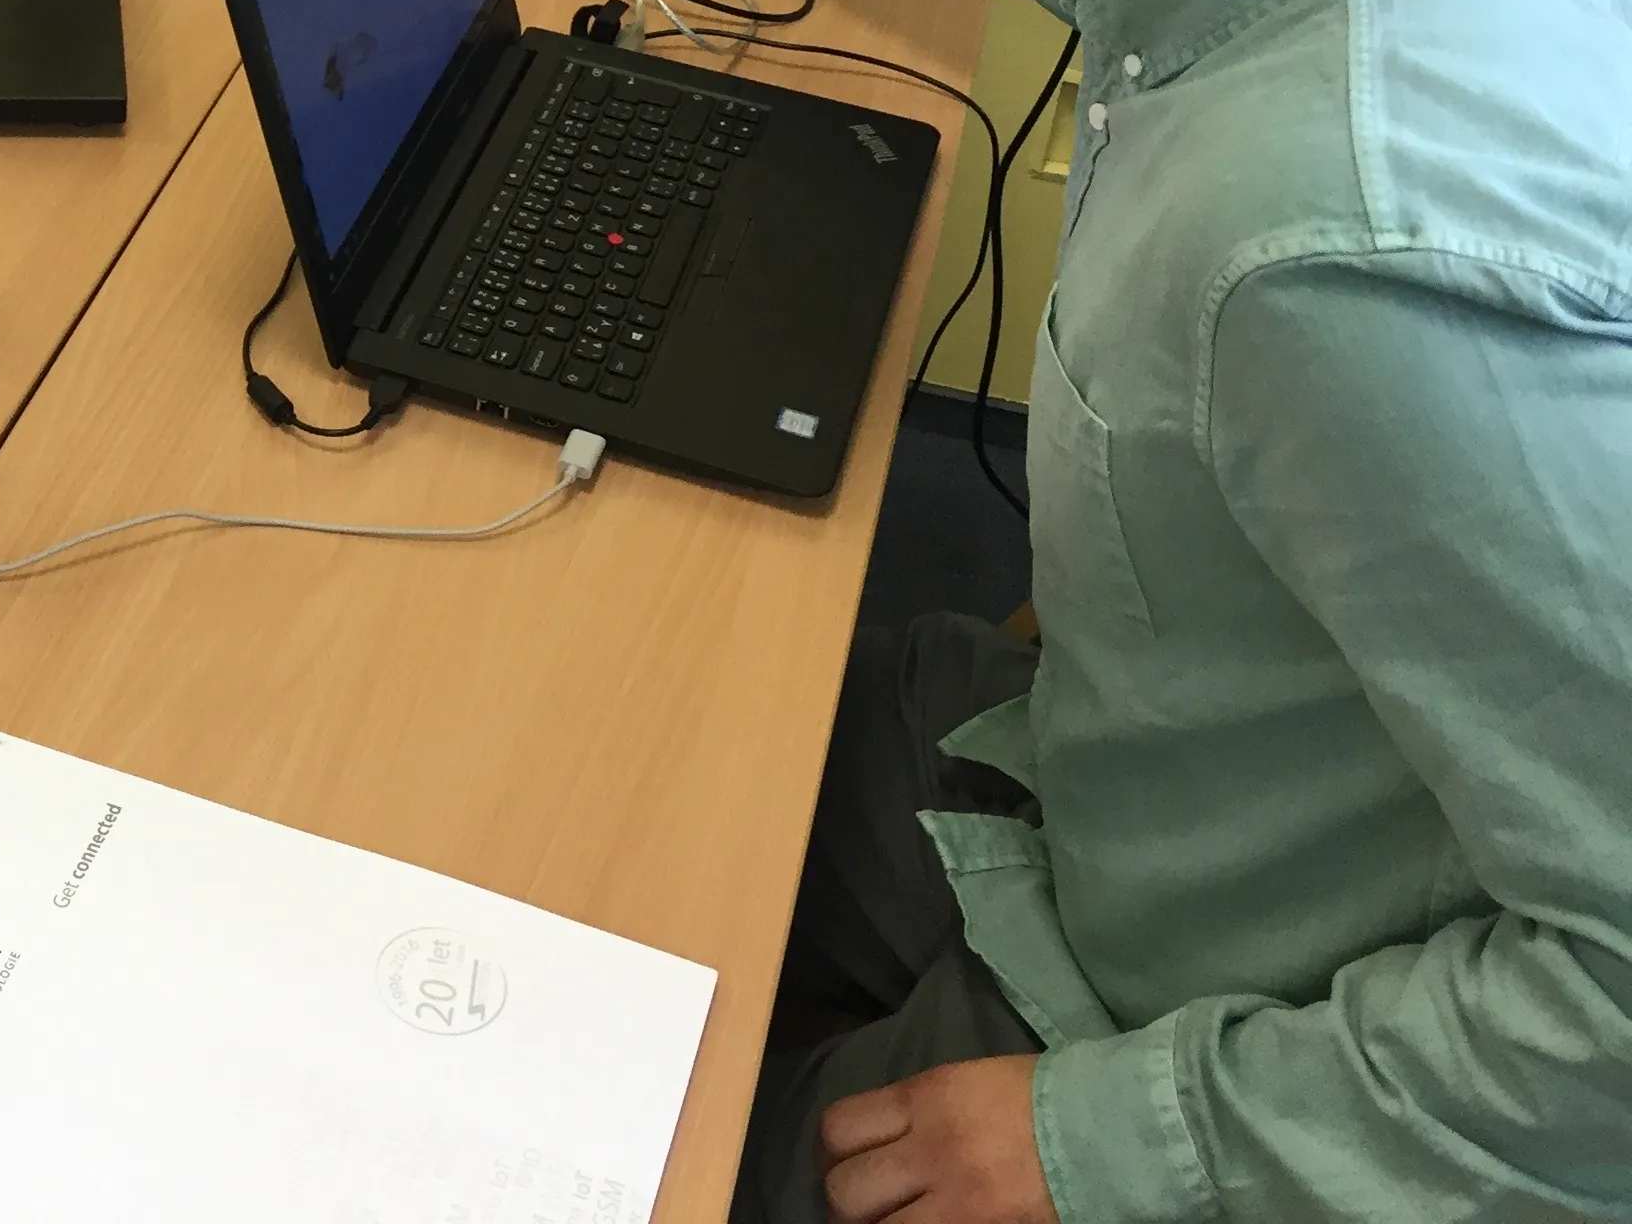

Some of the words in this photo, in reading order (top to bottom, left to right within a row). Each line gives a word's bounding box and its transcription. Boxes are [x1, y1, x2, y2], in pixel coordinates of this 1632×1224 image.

[53, 880, 80, 908] Get
[72, 802, 123, 880] connected
[426, 938, 453, 966] let
[414, 978, 458, 1027] 20
